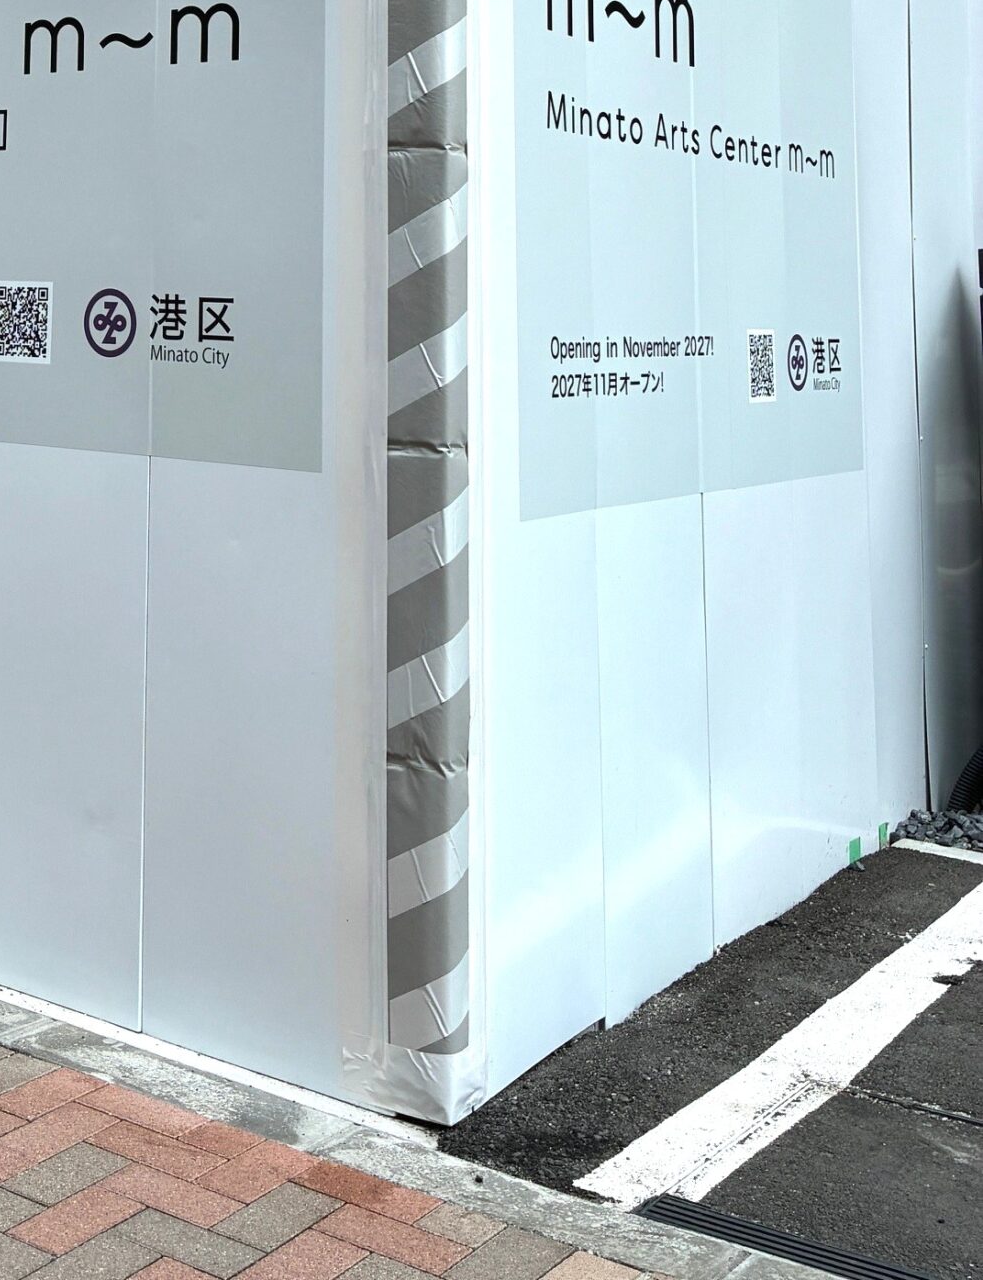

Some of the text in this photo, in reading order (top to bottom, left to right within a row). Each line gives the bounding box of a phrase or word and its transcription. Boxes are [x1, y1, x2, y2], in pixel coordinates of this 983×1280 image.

[546, 90, 644, 145] Minato
[654, 112, 701, 156] Arts
[710, 124, 782, 169] Center
[149, 293, 235, 343] 港区
[150, 344, 230, 370] Minato City
[550, 335, 715, 365] Opening in November 2027!
[811, 336, 842, 375] 港区
[551, 370, 665, 399] 2027年11月オープン!
